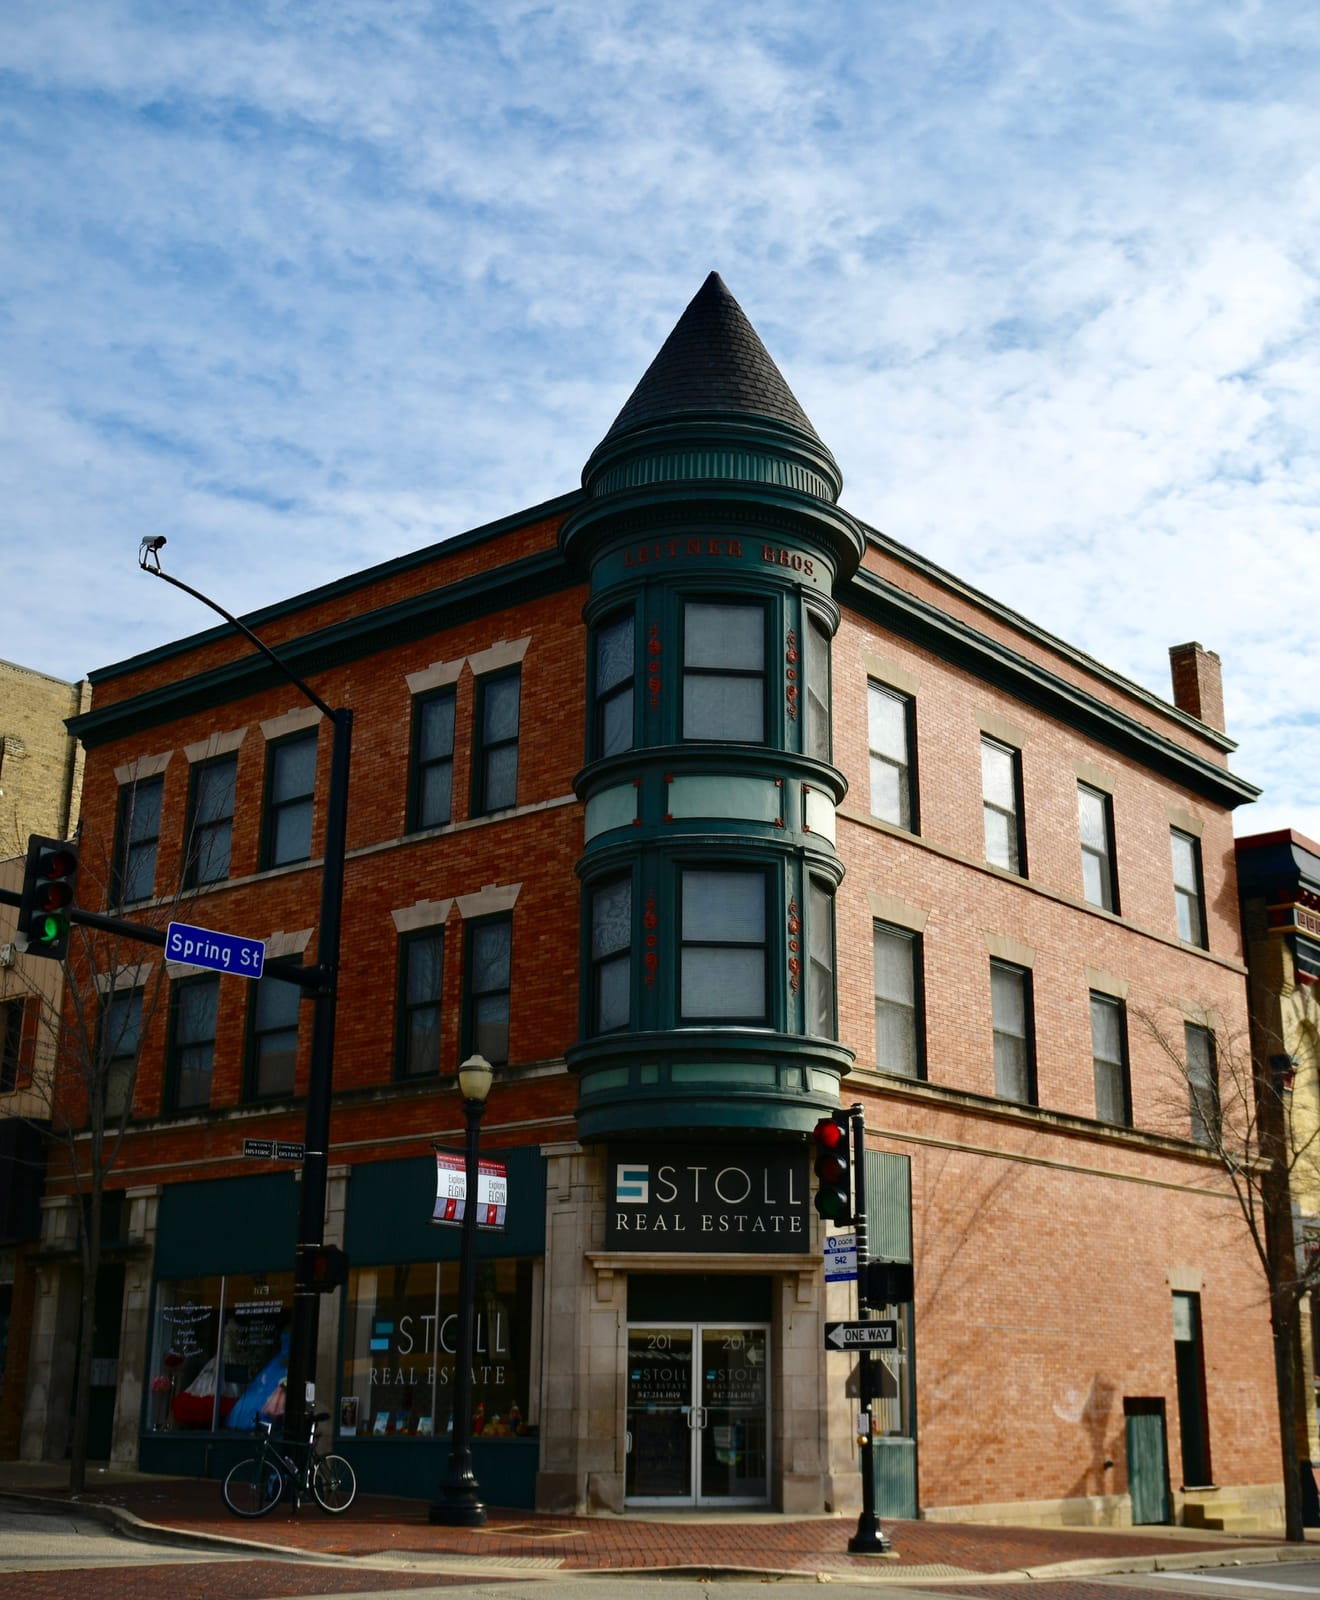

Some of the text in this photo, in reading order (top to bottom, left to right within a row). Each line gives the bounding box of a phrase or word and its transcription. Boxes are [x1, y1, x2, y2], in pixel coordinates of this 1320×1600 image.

[624, 538, 817, 583] LEITNER BROS.
[171, 933, 260, 968] Spring St
[448, 1173, 465, 1185] Explore
[655, 1165, 802, 1205] STOLL
[448, 1185, 465, 1199] ELGIN
[488, 1191, 506, 1204] ELGIN
[615, 1213, 802, 1233] REAL ESTATE
[834, 1256, 847, 1265] 542
[647, 1334, 671, 1349] 201
[845, 1328, 889, 1341] ONE WAY
[721, 1335, 745, 1350] 201
[369, 1367, 418, 1385] REAL
[643, 1368, 688, 1381] STOLL
